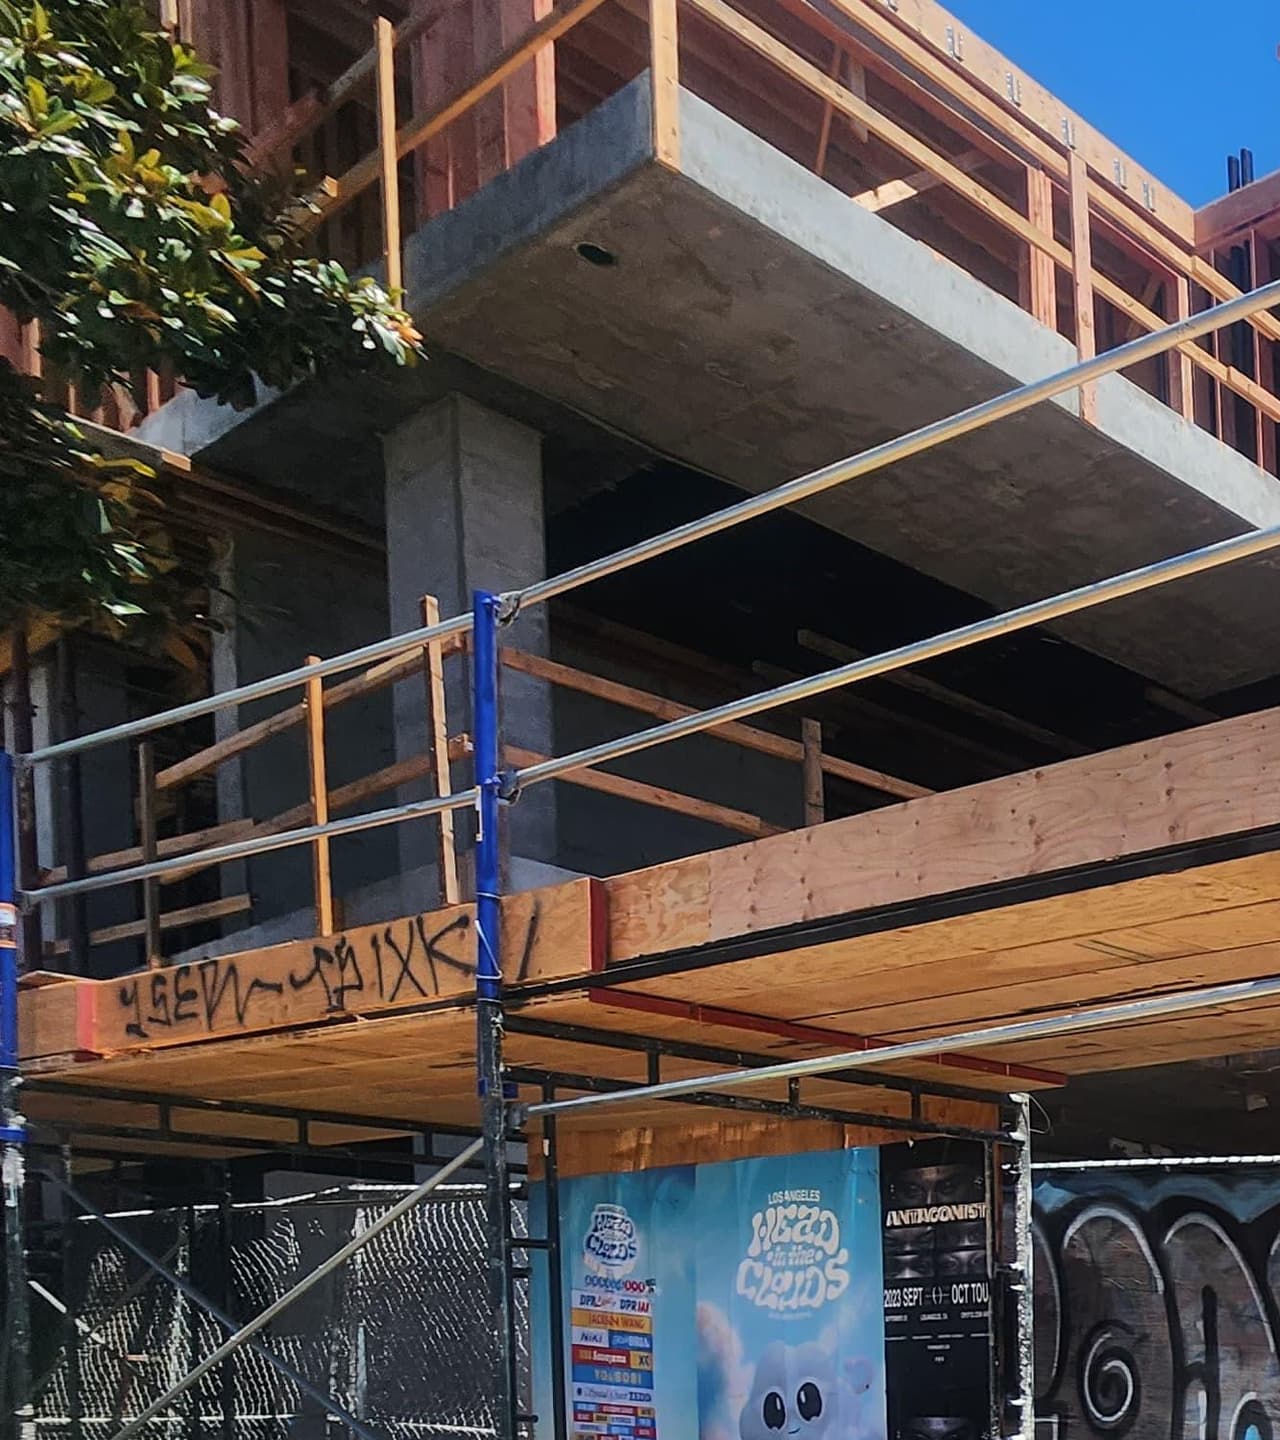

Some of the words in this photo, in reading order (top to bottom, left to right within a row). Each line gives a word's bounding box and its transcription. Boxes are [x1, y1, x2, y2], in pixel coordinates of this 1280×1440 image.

[768, 1191, 783, 1204] LOS
[783, 1189, 821, 1203] ANGELES
[886, 1202, 987, 1227] ANTAGONIST
[884, 1288, 902, 1307] 2023
[903, 1286, 924, 1307] SEPT
[951, 1283, 970, 1304] OCT
[971, 1282, 990, 1303] TOU
